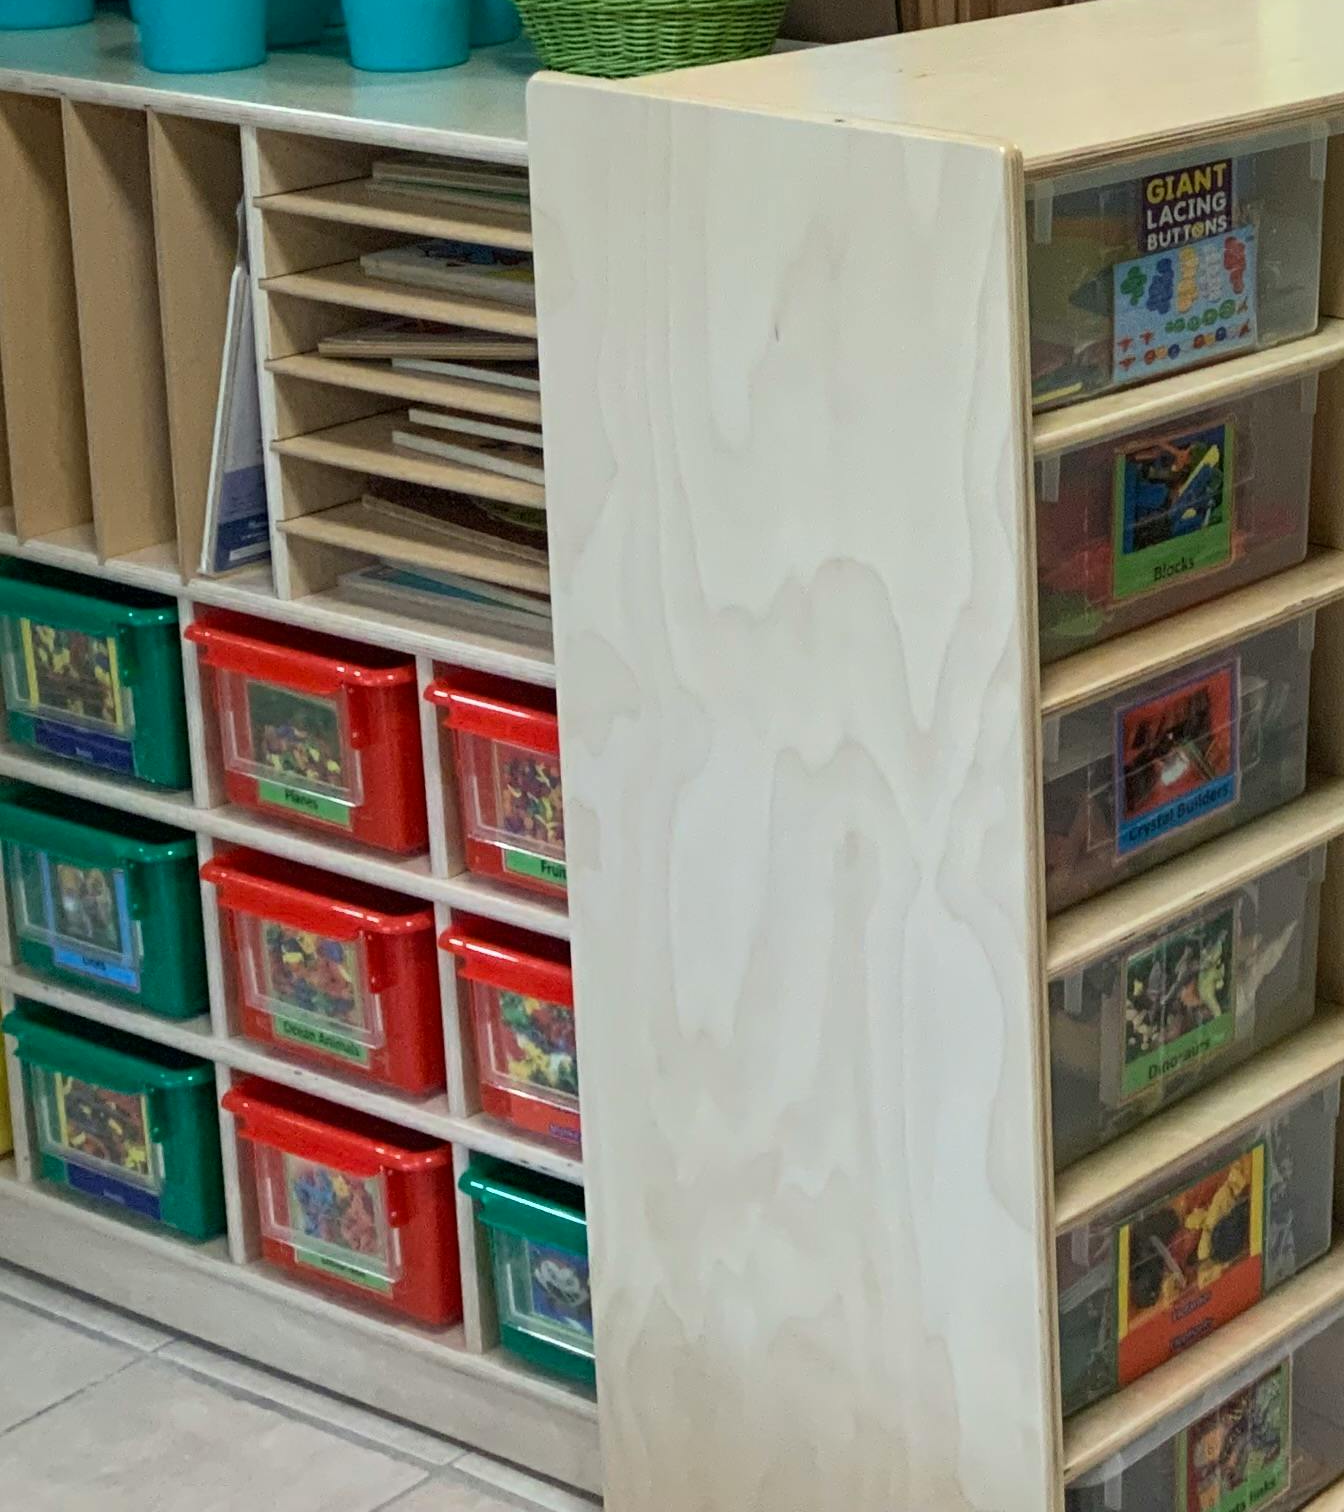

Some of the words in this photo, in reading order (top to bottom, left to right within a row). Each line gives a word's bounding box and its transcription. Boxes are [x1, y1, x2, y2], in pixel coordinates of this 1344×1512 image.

[1146, 162, 1229, 205] GIANT
[1147, 191, 1227, 230] LACING
[1147, 215, 1228, 251] BUTTONS
[1153, 556, 1195, 581] Blocks
[284, 788, 318, 810] Planes
[1126, 810, 1175, 842] Crystal
[1177, 786, 1230, 820] Builders
[541, 859, 567, 880] Frui
[284, 1020, 316, 1042] Ocean
[319, 1031, 361, 1057] Animals
